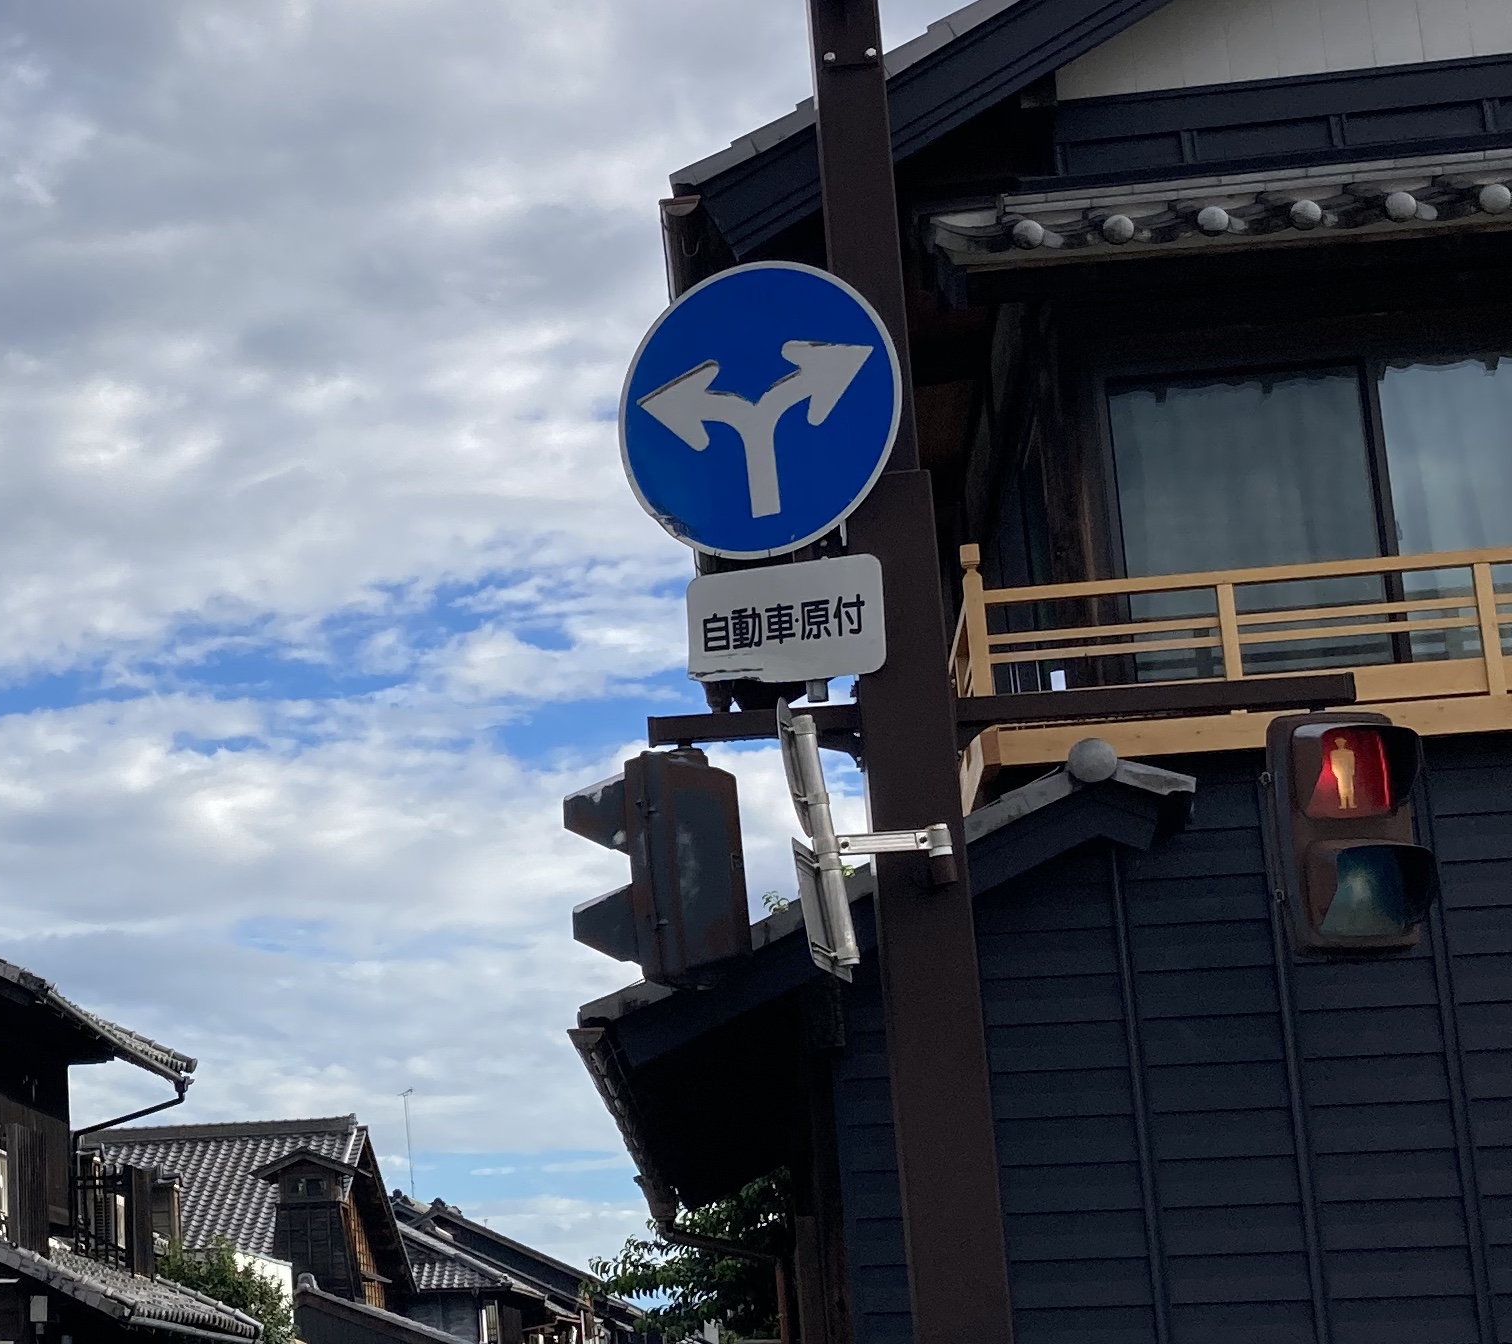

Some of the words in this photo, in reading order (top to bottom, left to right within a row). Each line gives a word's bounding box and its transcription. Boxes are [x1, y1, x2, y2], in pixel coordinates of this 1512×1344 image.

[702, 593, 866, 653] 自動車・原付
